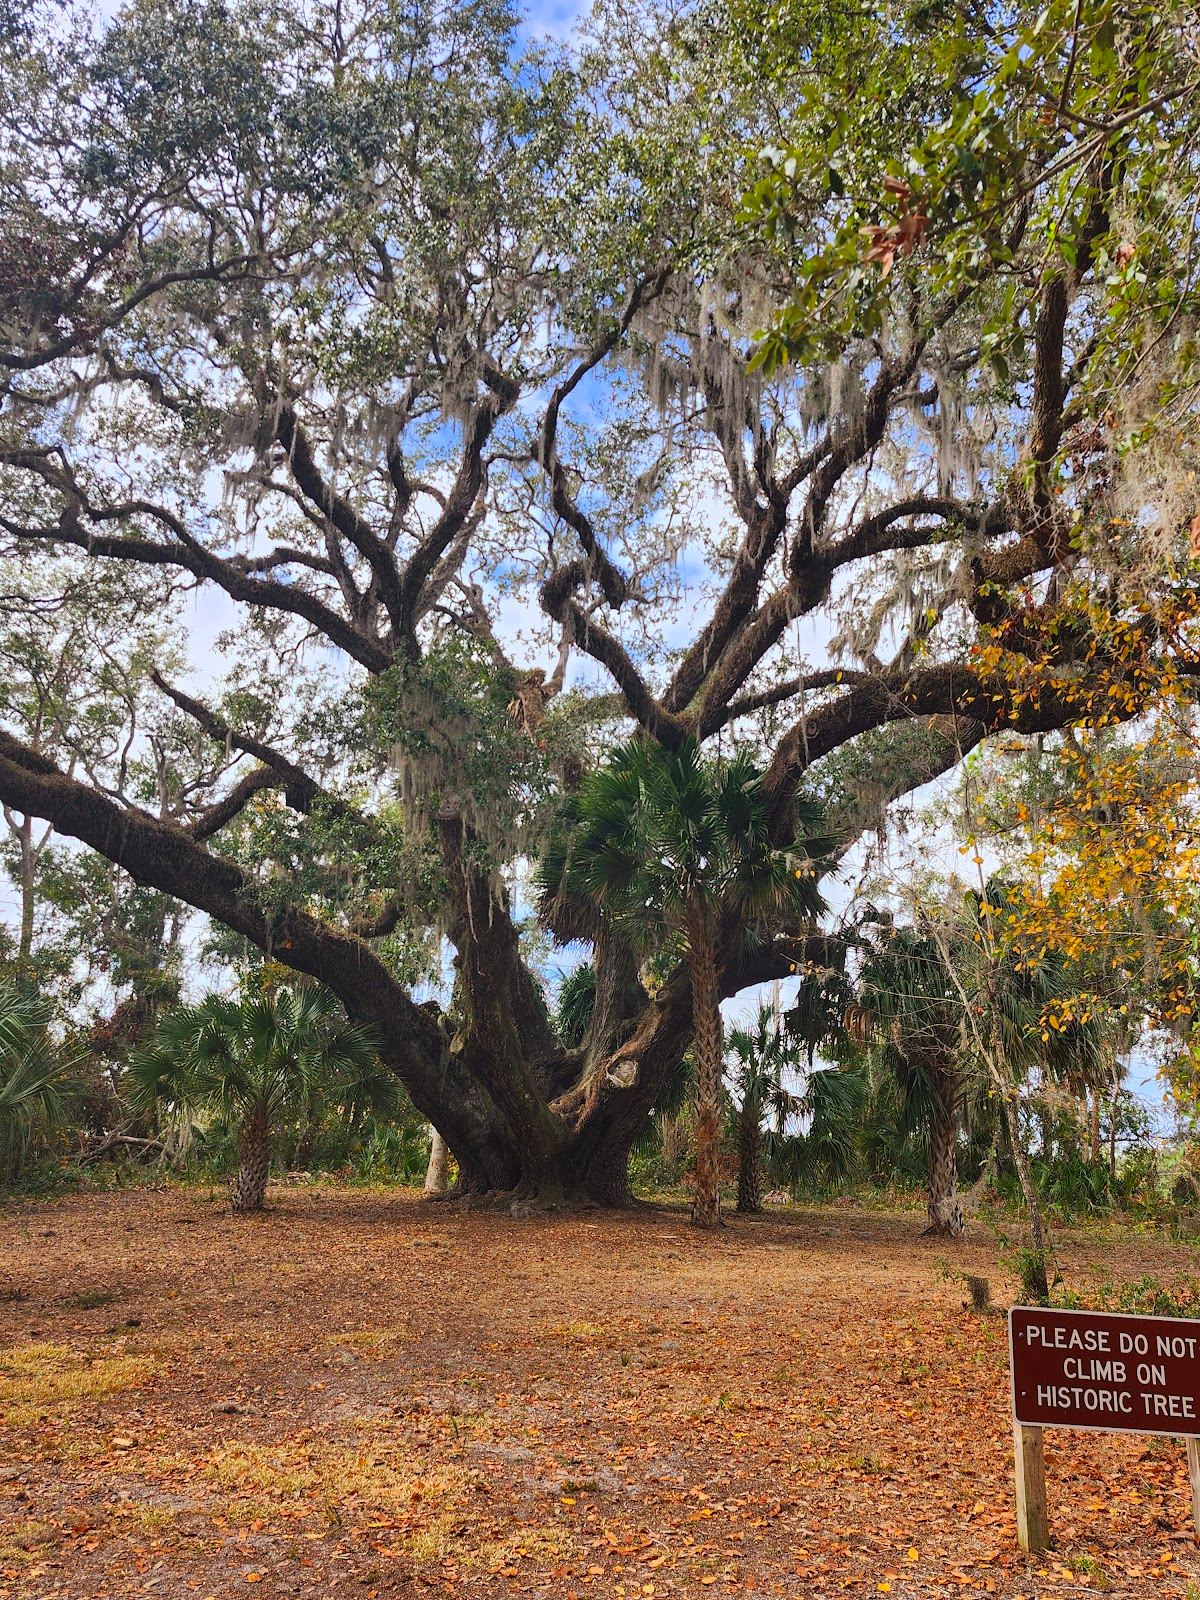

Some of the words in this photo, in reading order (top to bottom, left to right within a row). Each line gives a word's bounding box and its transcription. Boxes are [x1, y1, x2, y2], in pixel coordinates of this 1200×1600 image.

[1026, 1325, 1111, 1352] PLEASE
[1119, 1332, 1149, 1355] DO
[1156, 1335, 1197, 1359] NOT
[1063, 1357, 1127, 1383] CLIMB
[1136, 1363, 1166, 1386] ON
[1037, 1385, 1133, 1413] HISTORIC
[1140, 1393, 1196, 1418] TREE
